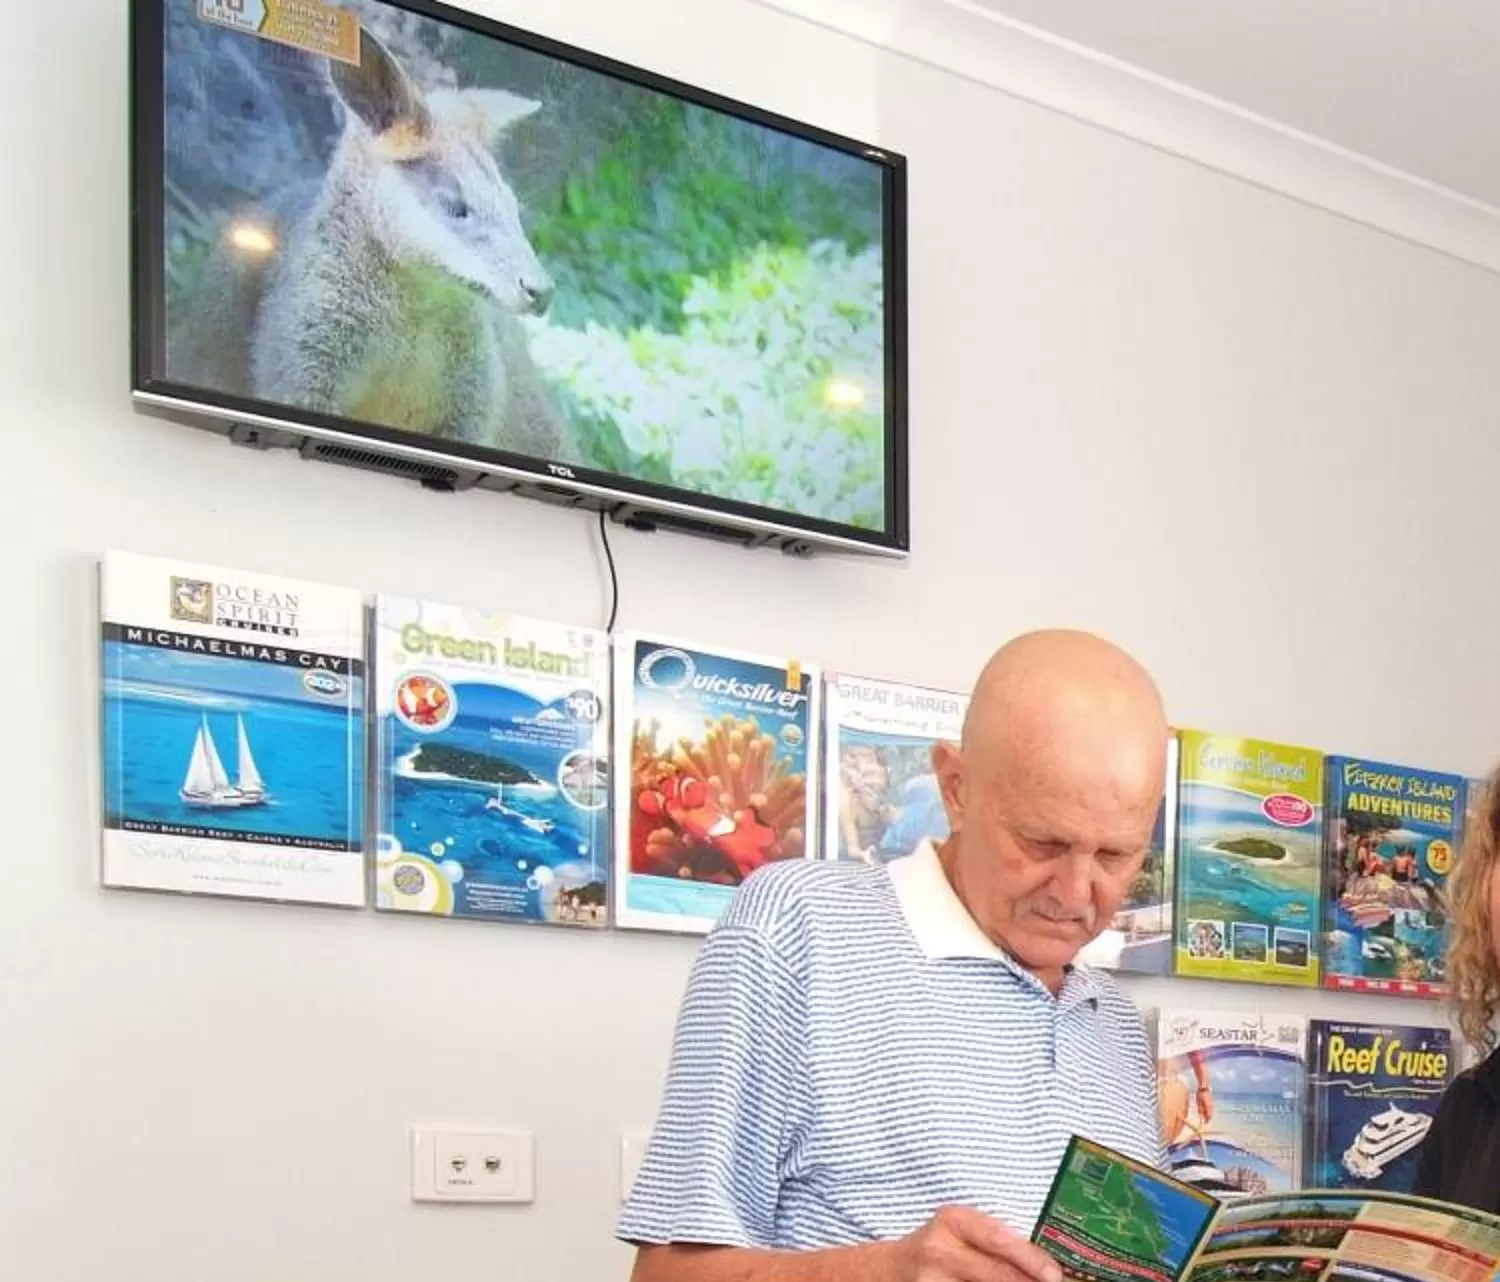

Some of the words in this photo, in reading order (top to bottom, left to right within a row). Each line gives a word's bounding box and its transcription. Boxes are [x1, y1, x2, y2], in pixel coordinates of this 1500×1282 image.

[548, 463, 576, 478] TCL
[216, 584, 299, 608] OCEAN
[216, 603, 299, 627] SPIRIT
[126, 628, 287, 662] MICHAELMAS
[299, 654, 341, 670] CAY
[402, 624, 497, 667] Green
[503, 637, 591, 678] Island
[638, 648, 808, 708] Quicksilver
[840, 684, 890, 704] GREAT
[895, 691, 960, 715] BARRIER
[1407, 778, 1457, 801] ISLAND
[1347, 793, 1452, 824] ADVENTURES
[1200, 1027, 1258, 1041] SEASTAR
[1327, 1034, 1383, 1074] Reef
[1384, 1040, 1448, 1078] Cruise
